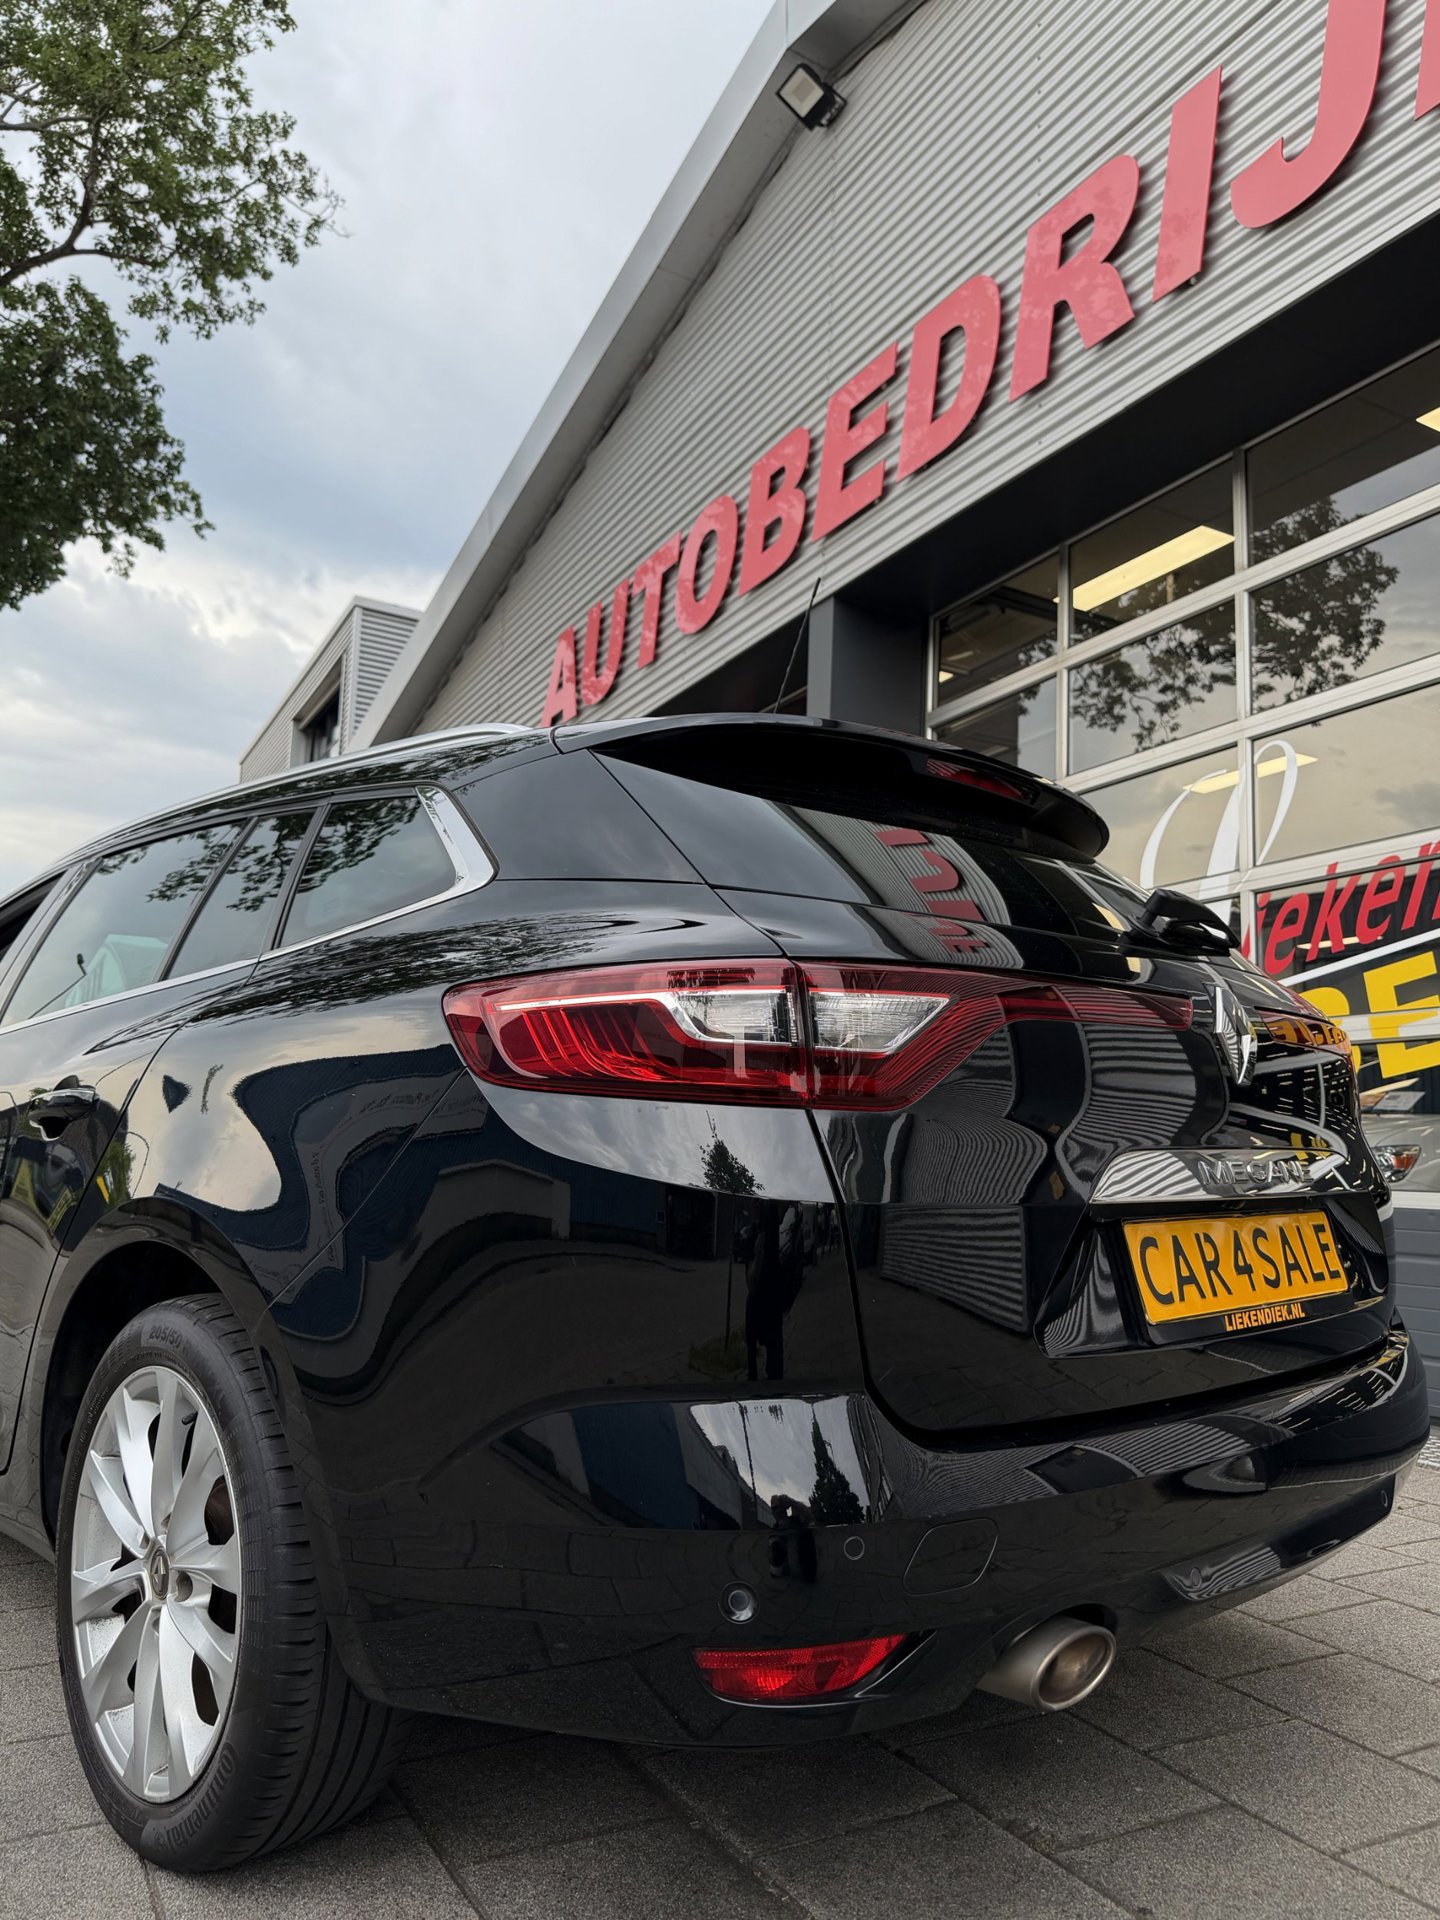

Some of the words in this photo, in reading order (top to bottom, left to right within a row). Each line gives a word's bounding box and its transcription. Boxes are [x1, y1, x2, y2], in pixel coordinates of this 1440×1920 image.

[540, 0, 1440, 727] AUTOBEDRIJ
[1198, 1160, 1315, 1185] MEGANE
[1224, 1303, 1306, 1332] LIEKENDIEK.NL
